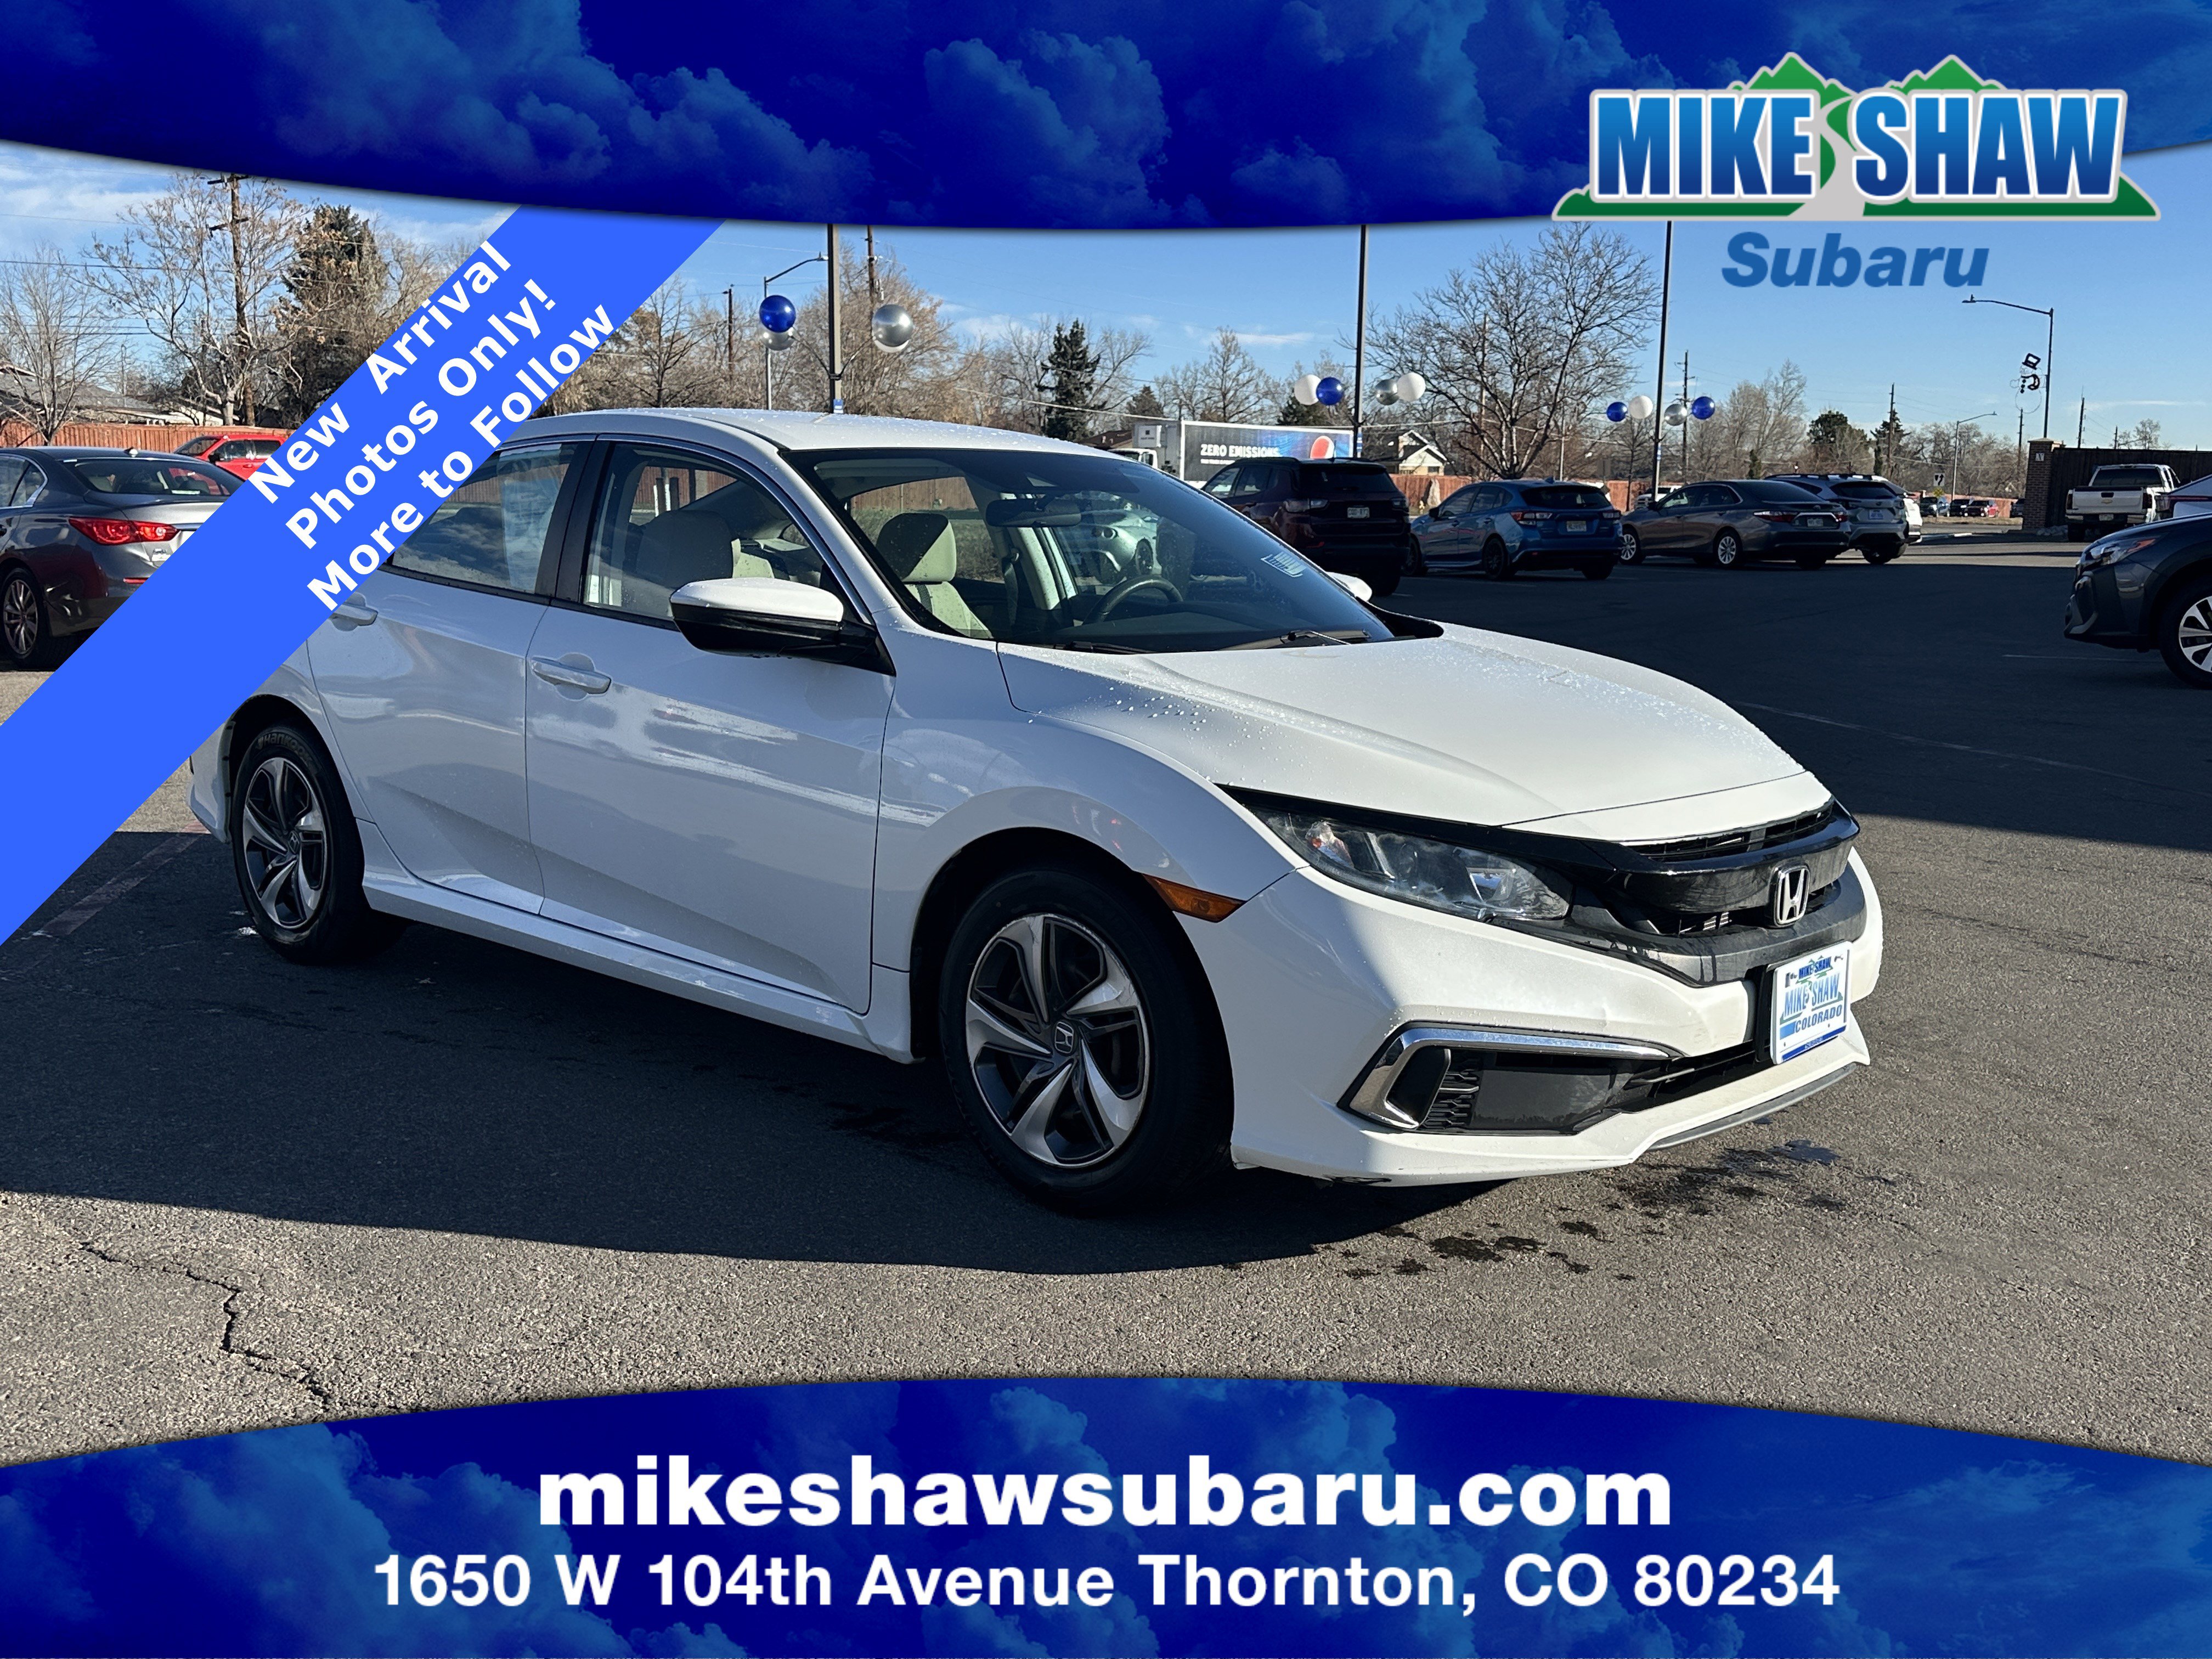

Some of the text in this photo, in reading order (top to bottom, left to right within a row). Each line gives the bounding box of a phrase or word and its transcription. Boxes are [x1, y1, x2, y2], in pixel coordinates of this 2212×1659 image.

[1200, 443, 1280, 458] ZERO EMISSIONS
[1798, 956, 1832, 979] MIKE SHAW
[1784, 973, 1840, 1017] MIKE SHAW
[1795, 1004, 1843, 1033] COLORADO
